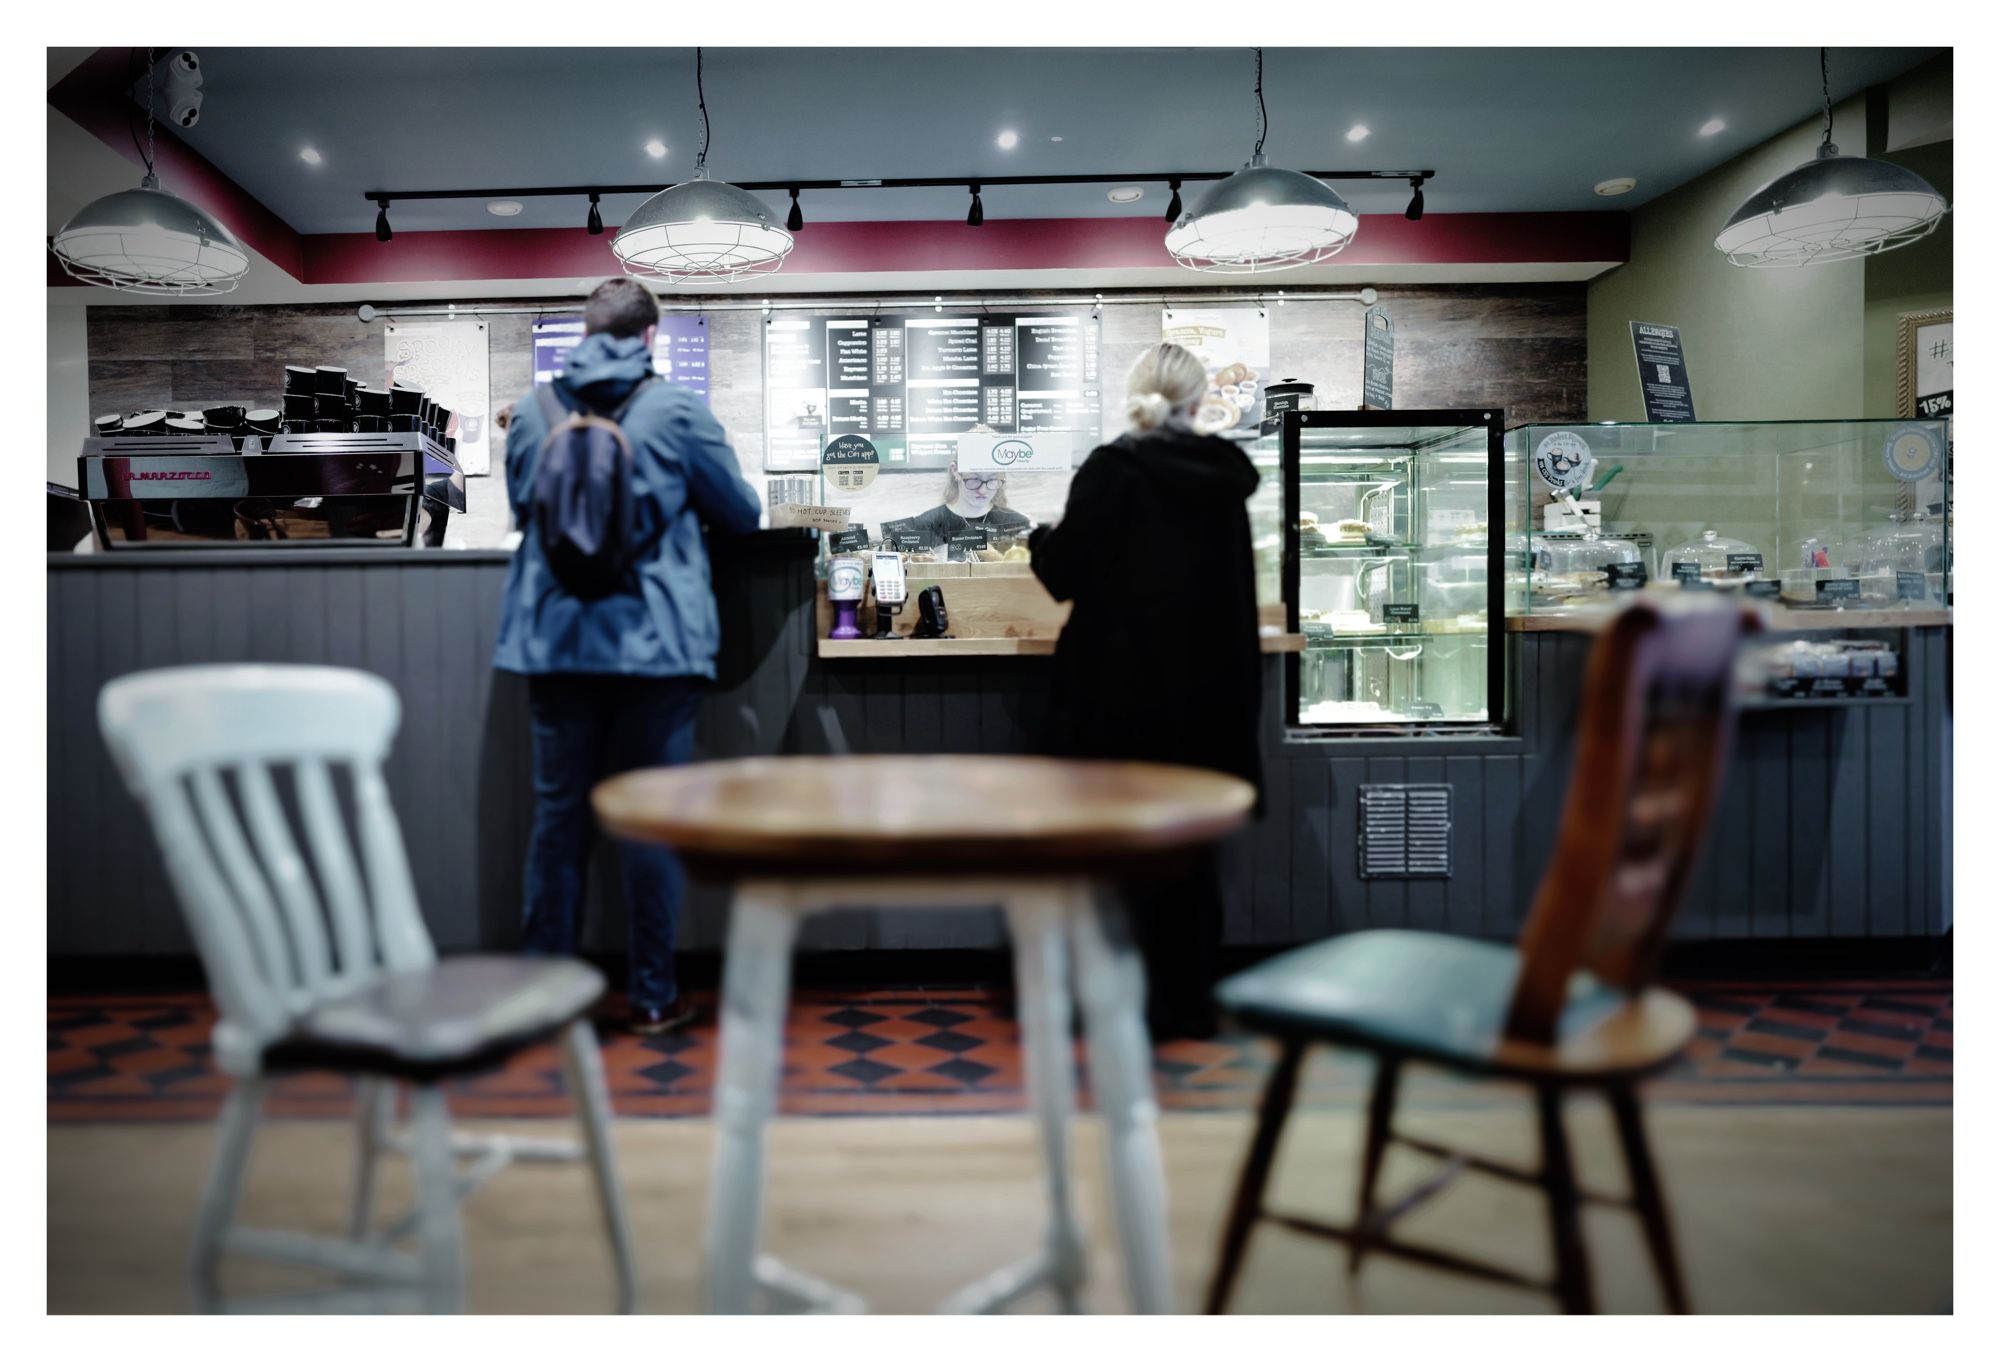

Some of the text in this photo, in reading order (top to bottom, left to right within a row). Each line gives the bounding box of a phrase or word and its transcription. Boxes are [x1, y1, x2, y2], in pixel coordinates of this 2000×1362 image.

[1918, 395, 1952, 414] 15%
[852, 443, 864, 451] you
[837, 450, 846, 458] the
[996, 449, 1033, 461] Maybe
